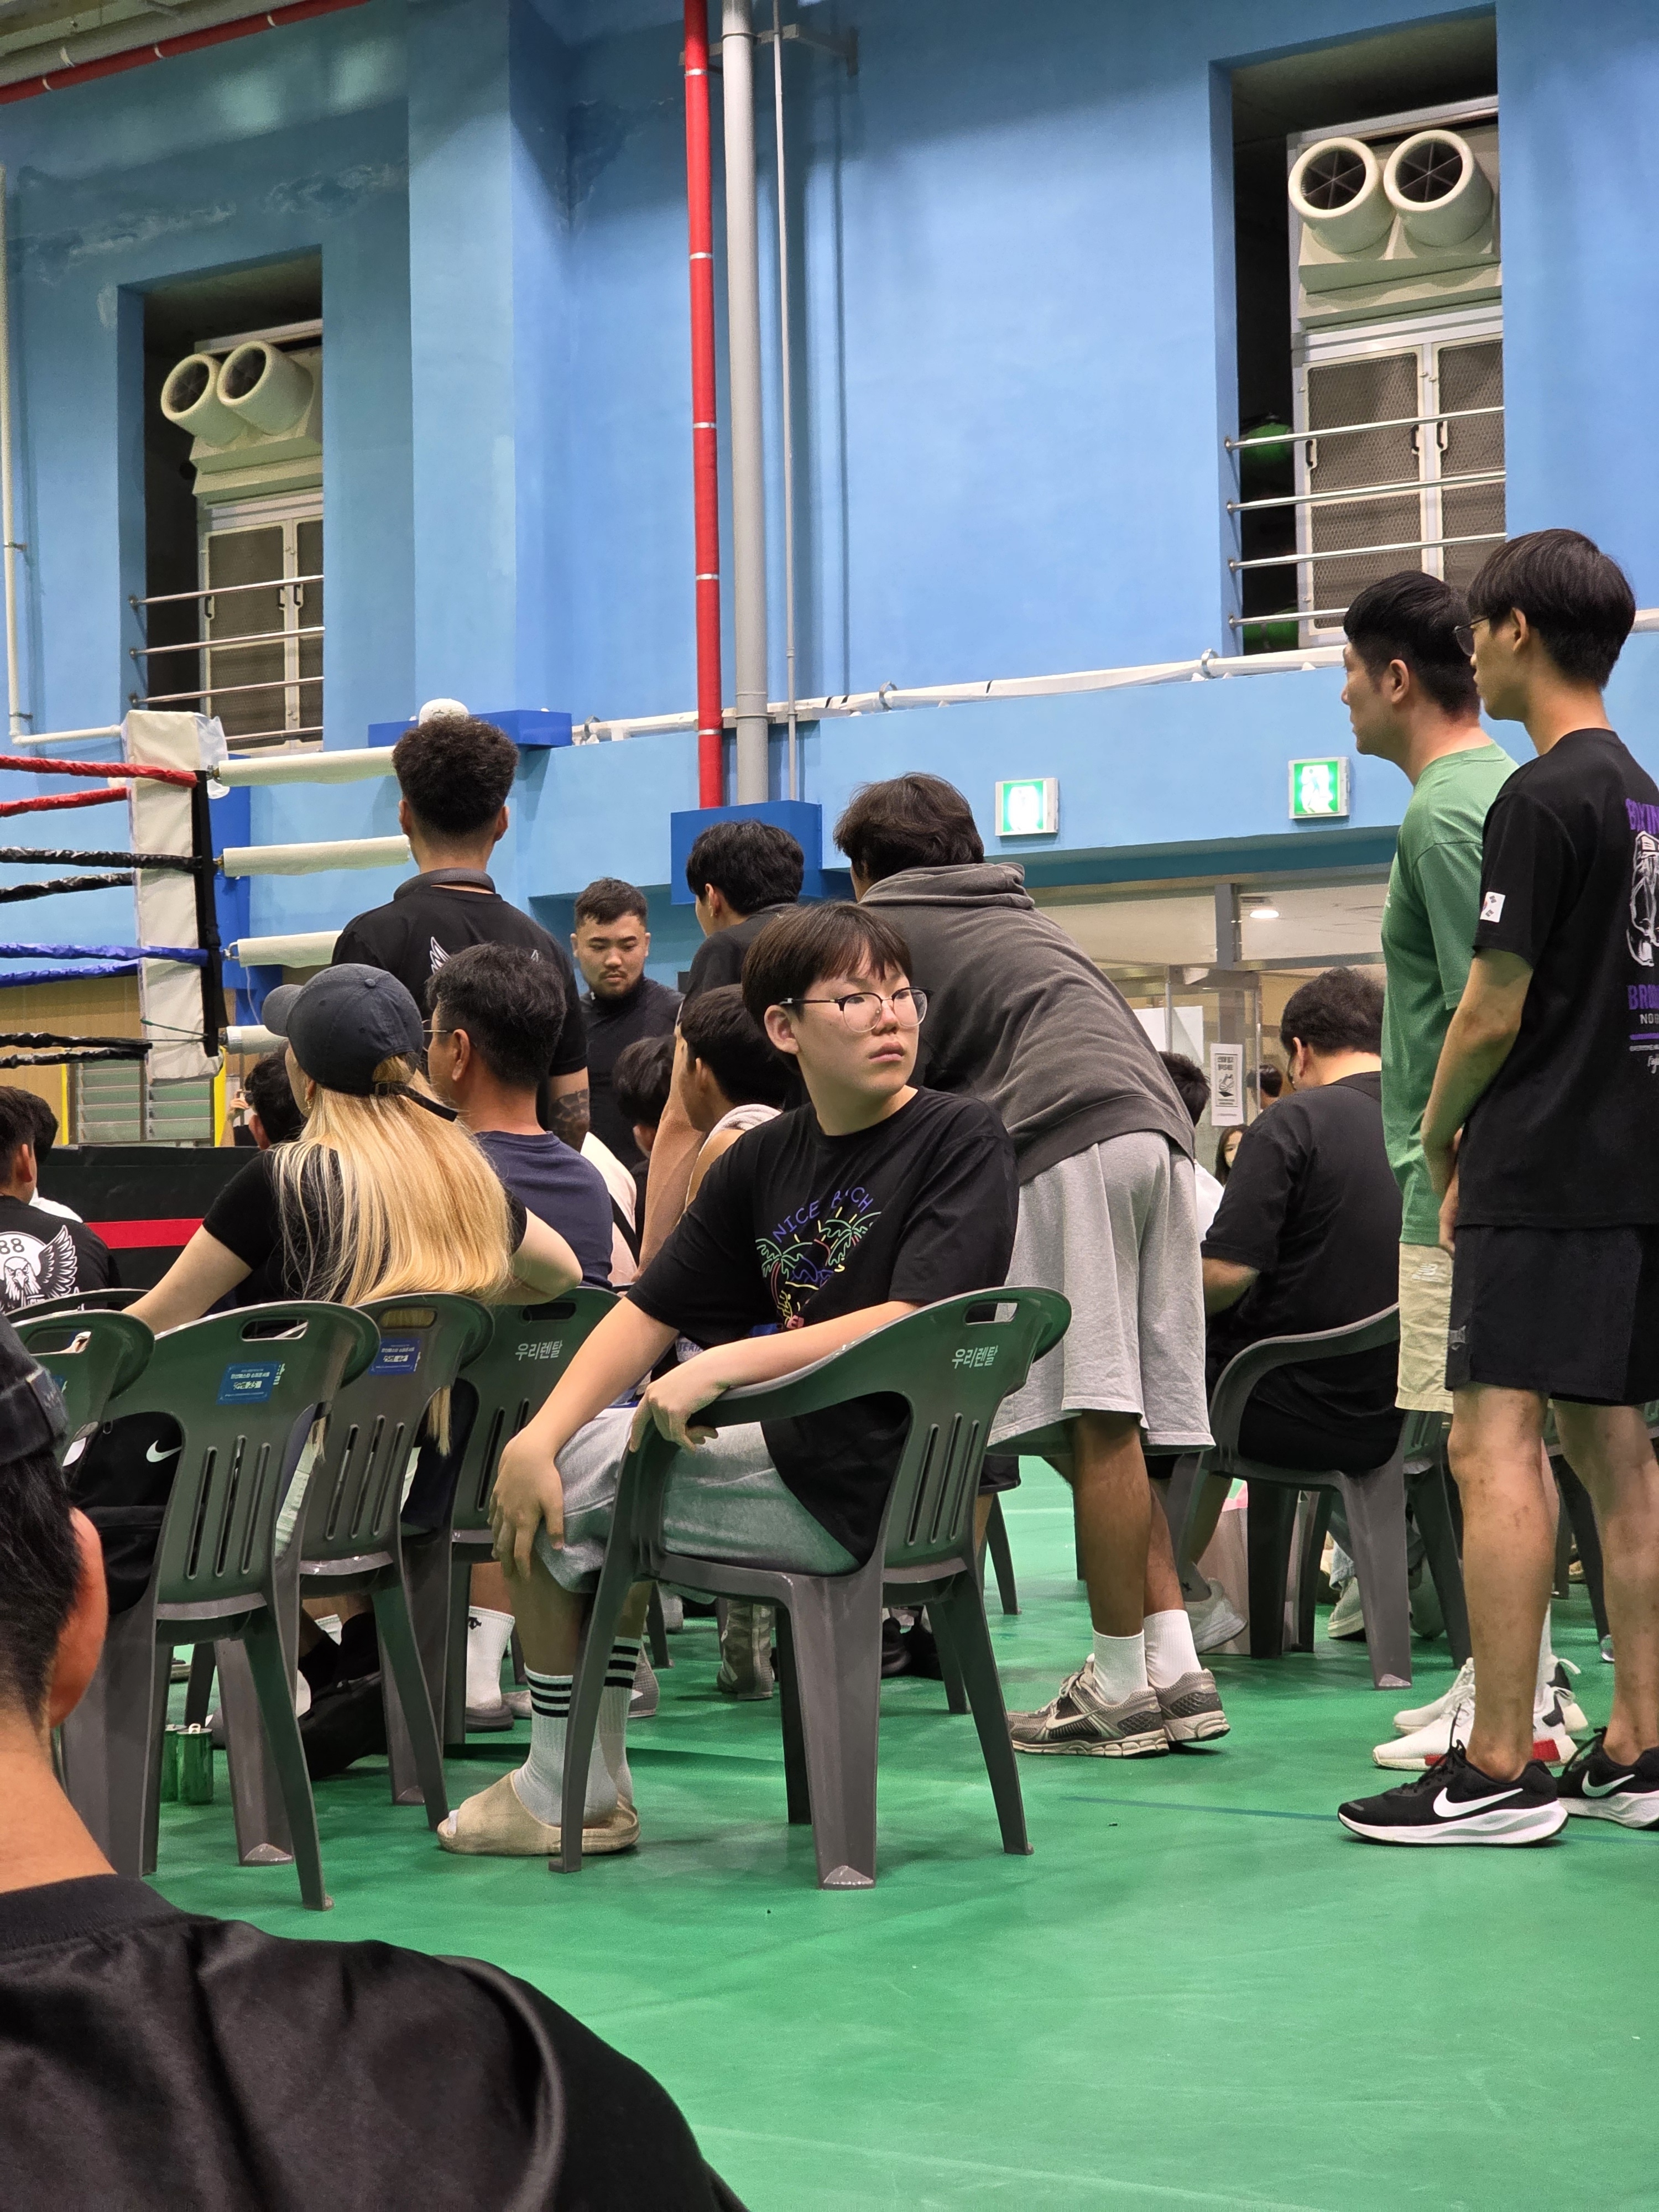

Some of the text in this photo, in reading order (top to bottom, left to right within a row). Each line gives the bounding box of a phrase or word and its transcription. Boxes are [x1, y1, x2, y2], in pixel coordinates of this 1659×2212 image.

[772, 1200, 820, 1243] NICE
[515, 1340, 563, 1361] 우리렌탈
[951, 1345, 999, 1369] 우리렌탈
